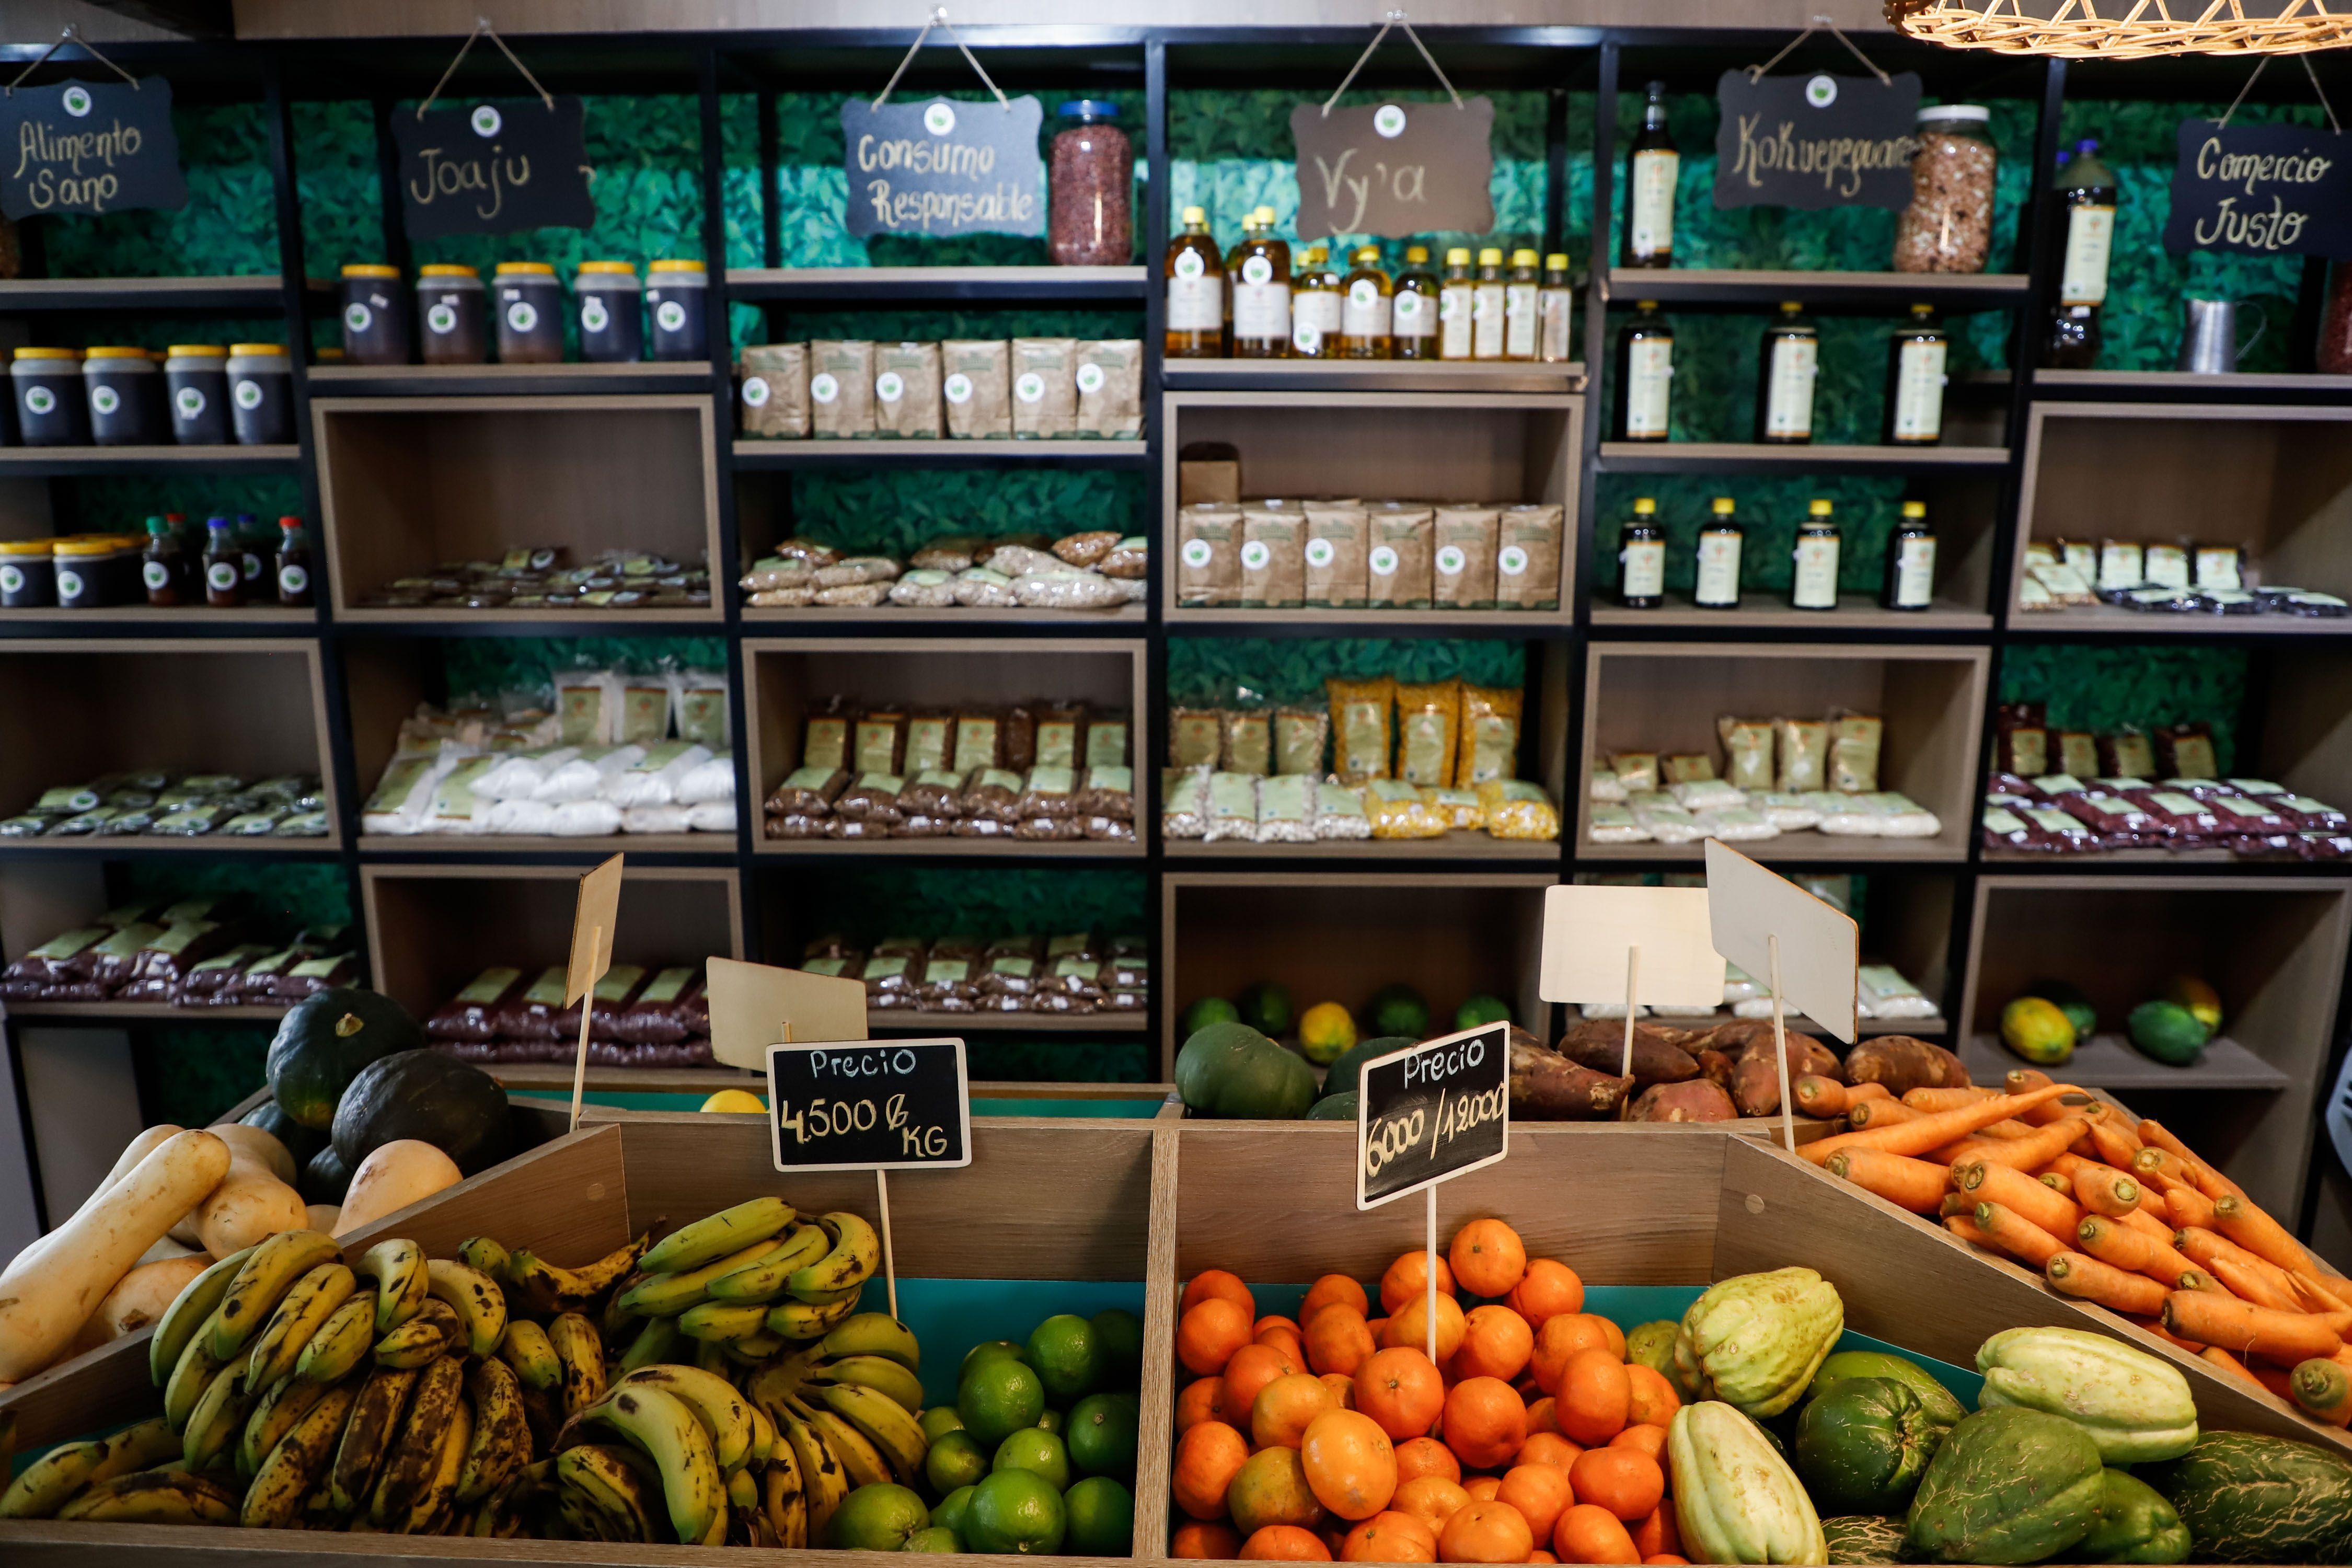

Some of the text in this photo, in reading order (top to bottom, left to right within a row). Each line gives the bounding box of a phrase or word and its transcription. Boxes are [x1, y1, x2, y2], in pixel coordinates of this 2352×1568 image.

[14, 118, 142, 176] Alimento
[858, 134, 994, 181] Consumo
[2197, 137, 2332, 195] Comercio
[29, 168, 118, 212] Sano
[410, 145, 530, 220] Joaju
[867, 179, 1033, 229] Responsable
[2195, 194, 2309, 250] Justo
[810, 1049, 916, 1078] Precio
[1404, 1039, 1484, 1090] Precio
[902, 1125, 947, 1158] KG
